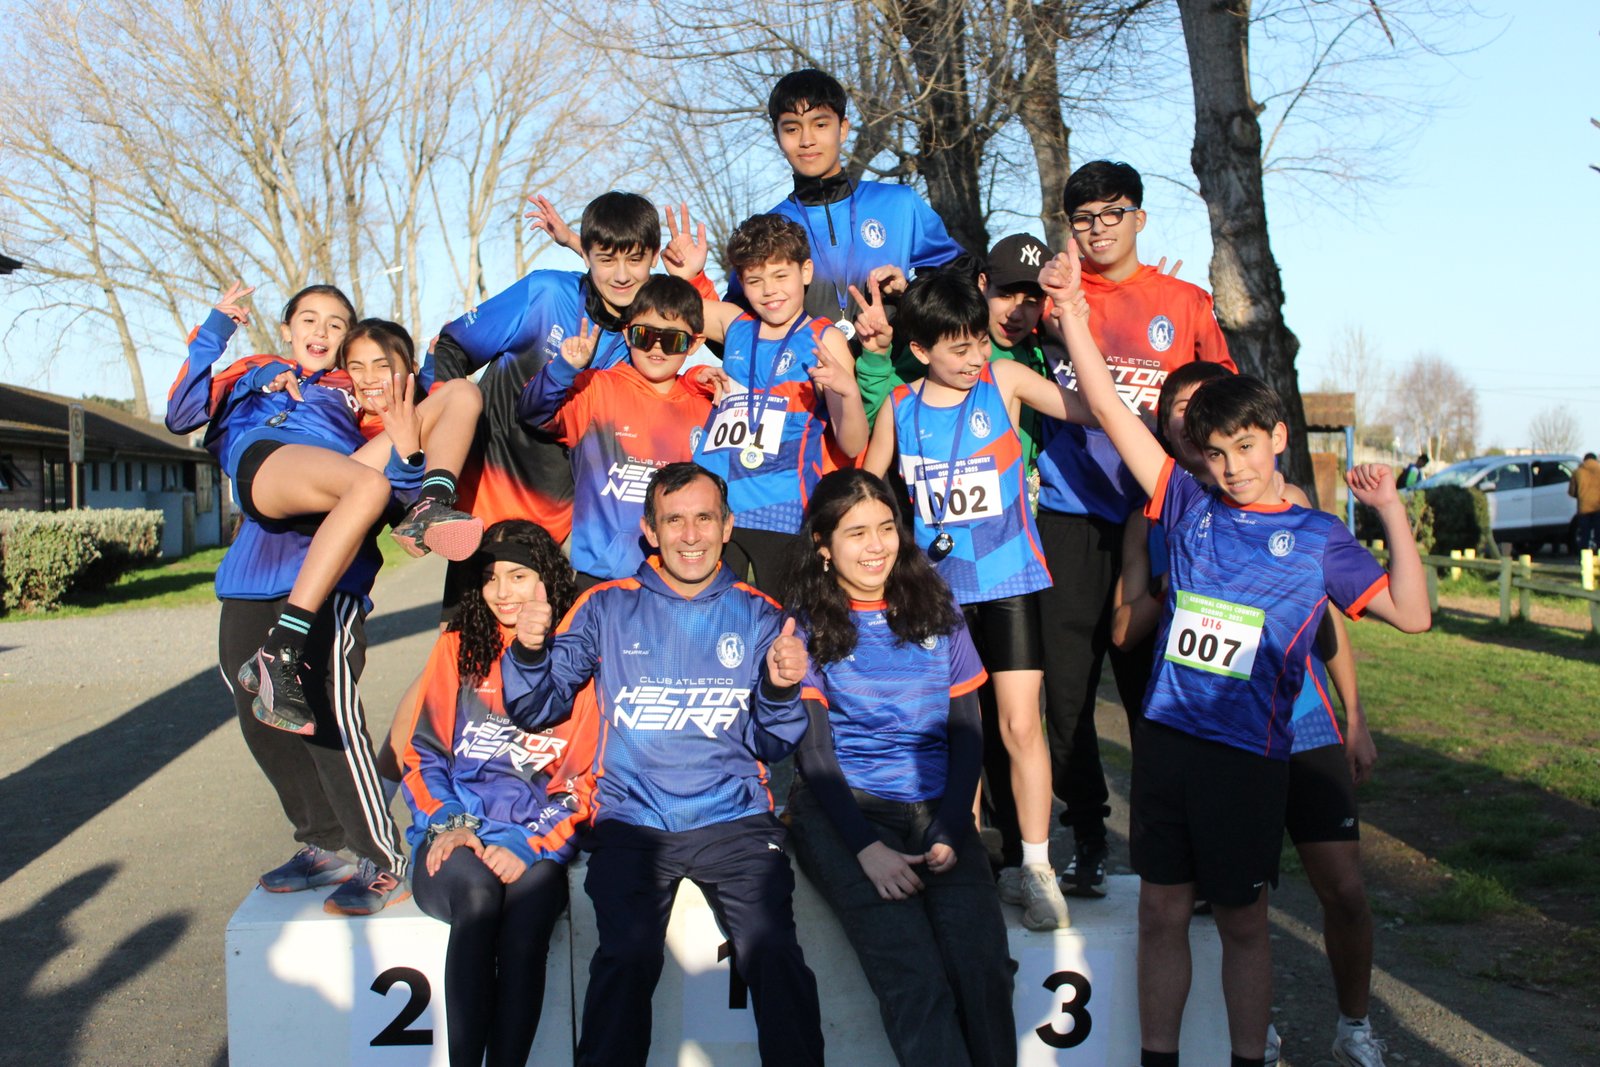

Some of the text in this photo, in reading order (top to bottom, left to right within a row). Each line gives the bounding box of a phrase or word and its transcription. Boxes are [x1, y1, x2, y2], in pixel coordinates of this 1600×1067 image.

[1020, 244, 1042, 267] NY
[1106, 355, 1161, 368] ATLETICO
[714, 421, 764, 450] 001
[627, 456, 654, 466] CLUB
[928, 485, 988, 516] 002
[1201, 616, 1222, 630] U16
[1178, 628, 1242, 667] 007
[639, 676, 734, 685] CLUB ATLETICO
[613, 685, 751, 711] HECTOR
[486, 713, 510, 725] CLUB
[613, 704, 740, 738] NEIRA
[462, 720, 569, 759] HECTOR
[453, 738, 556, 772] NEIRA
[369, 966, 434, 1047] 2
[1035, 970, 1093, 1049] 3
